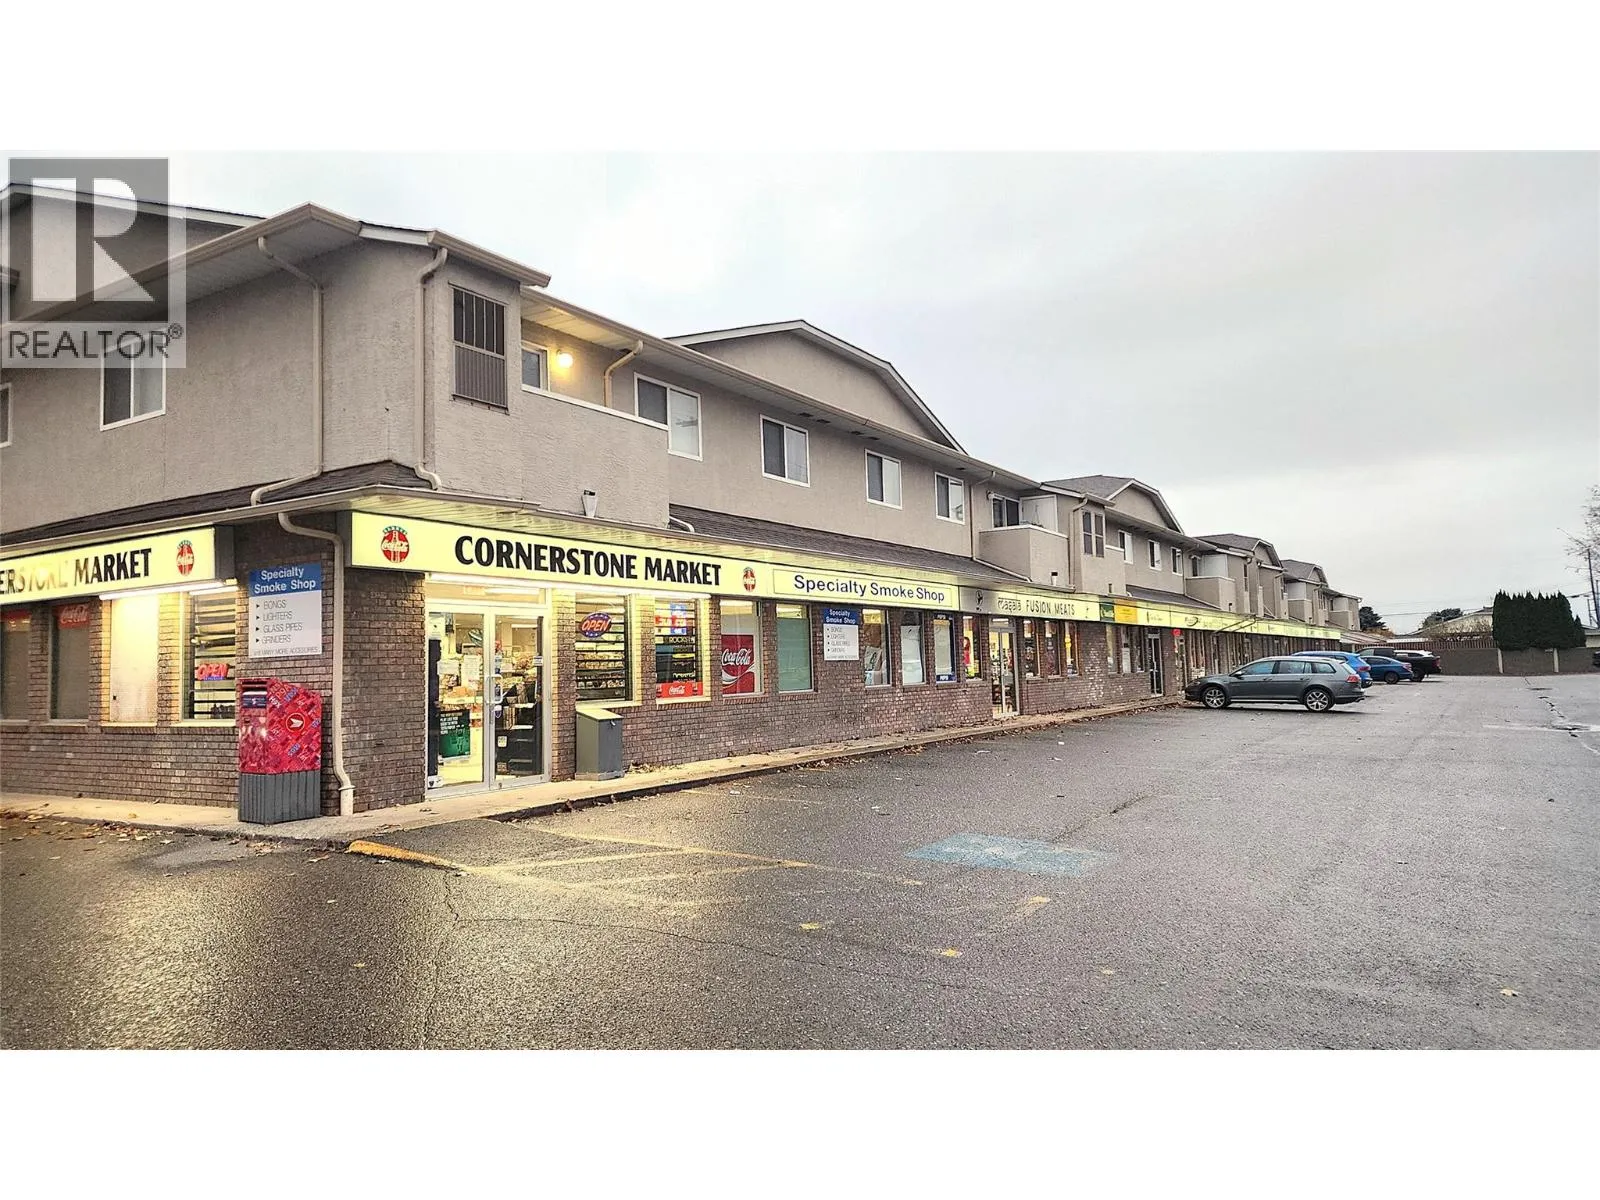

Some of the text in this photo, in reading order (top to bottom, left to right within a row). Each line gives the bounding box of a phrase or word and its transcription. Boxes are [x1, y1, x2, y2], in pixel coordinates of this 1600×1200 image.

[73, 547, 152, 587] MARKET
[454, 535, 722, 586] CORNERSTONE MARKET
[260, 566, 305, 582] Specialty
[253, 578, 317, 595] Smoke Shop
[793, 574, 945, 604] Specialty Smoke Shop
[263, 599, 288, 610] BONGS
[1026, 599, 1052, 614] FUSION
[1054, 602, 1076, 616] MEATS
[262, 610, 294, 622] LIGHTERS
[262, 622, 304, 634] GLASS PIPES
[581, 619, 611, 632] OPEN
[721, 648, 753, 667] Coca-Cola
[197, 663, 230, 680] OPEN
